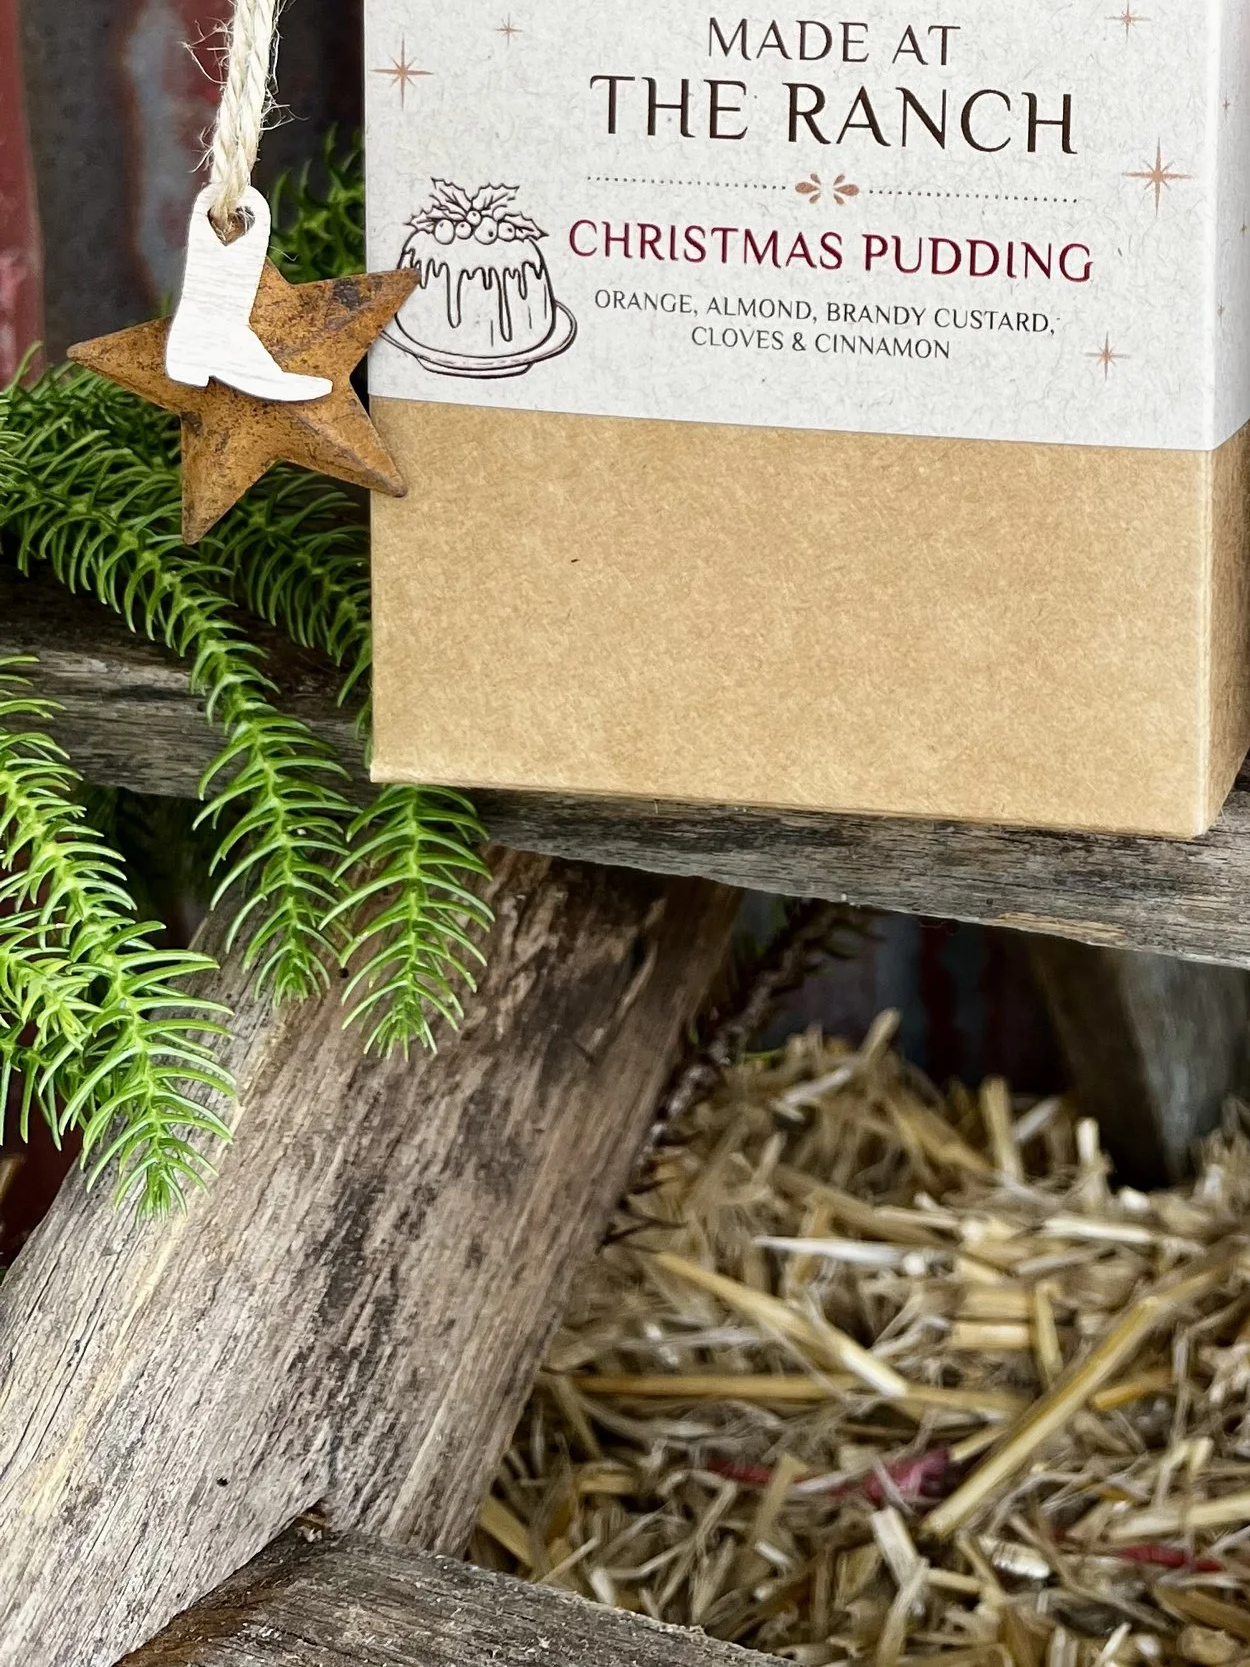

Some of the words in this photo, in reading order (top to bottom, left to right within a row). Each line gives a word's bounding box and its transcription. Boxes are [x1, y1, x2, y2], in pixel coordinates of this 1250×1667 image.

[708, 16, 870, 63] MADE
[891, 24, 962, 66] AT
[590, 75, 749, 141] THE
[782, 81, 1078, 155] RANCH
[569, 218, 843, 271] CHRISTMAS
[862, 233, 1094, 284] PUDDING
[595, 289, 698, 318] ORANGE,
[707, 296, 818, 325] ALMOND,
[827, 301, 927, 327] BRANDY
[934, 307, 1055, 336] CUSTARD,
[692, 325, 784, 351] CLOVES
[791, 331, 807, 352] &
[815, 333, 950, 360] CINNAMON
